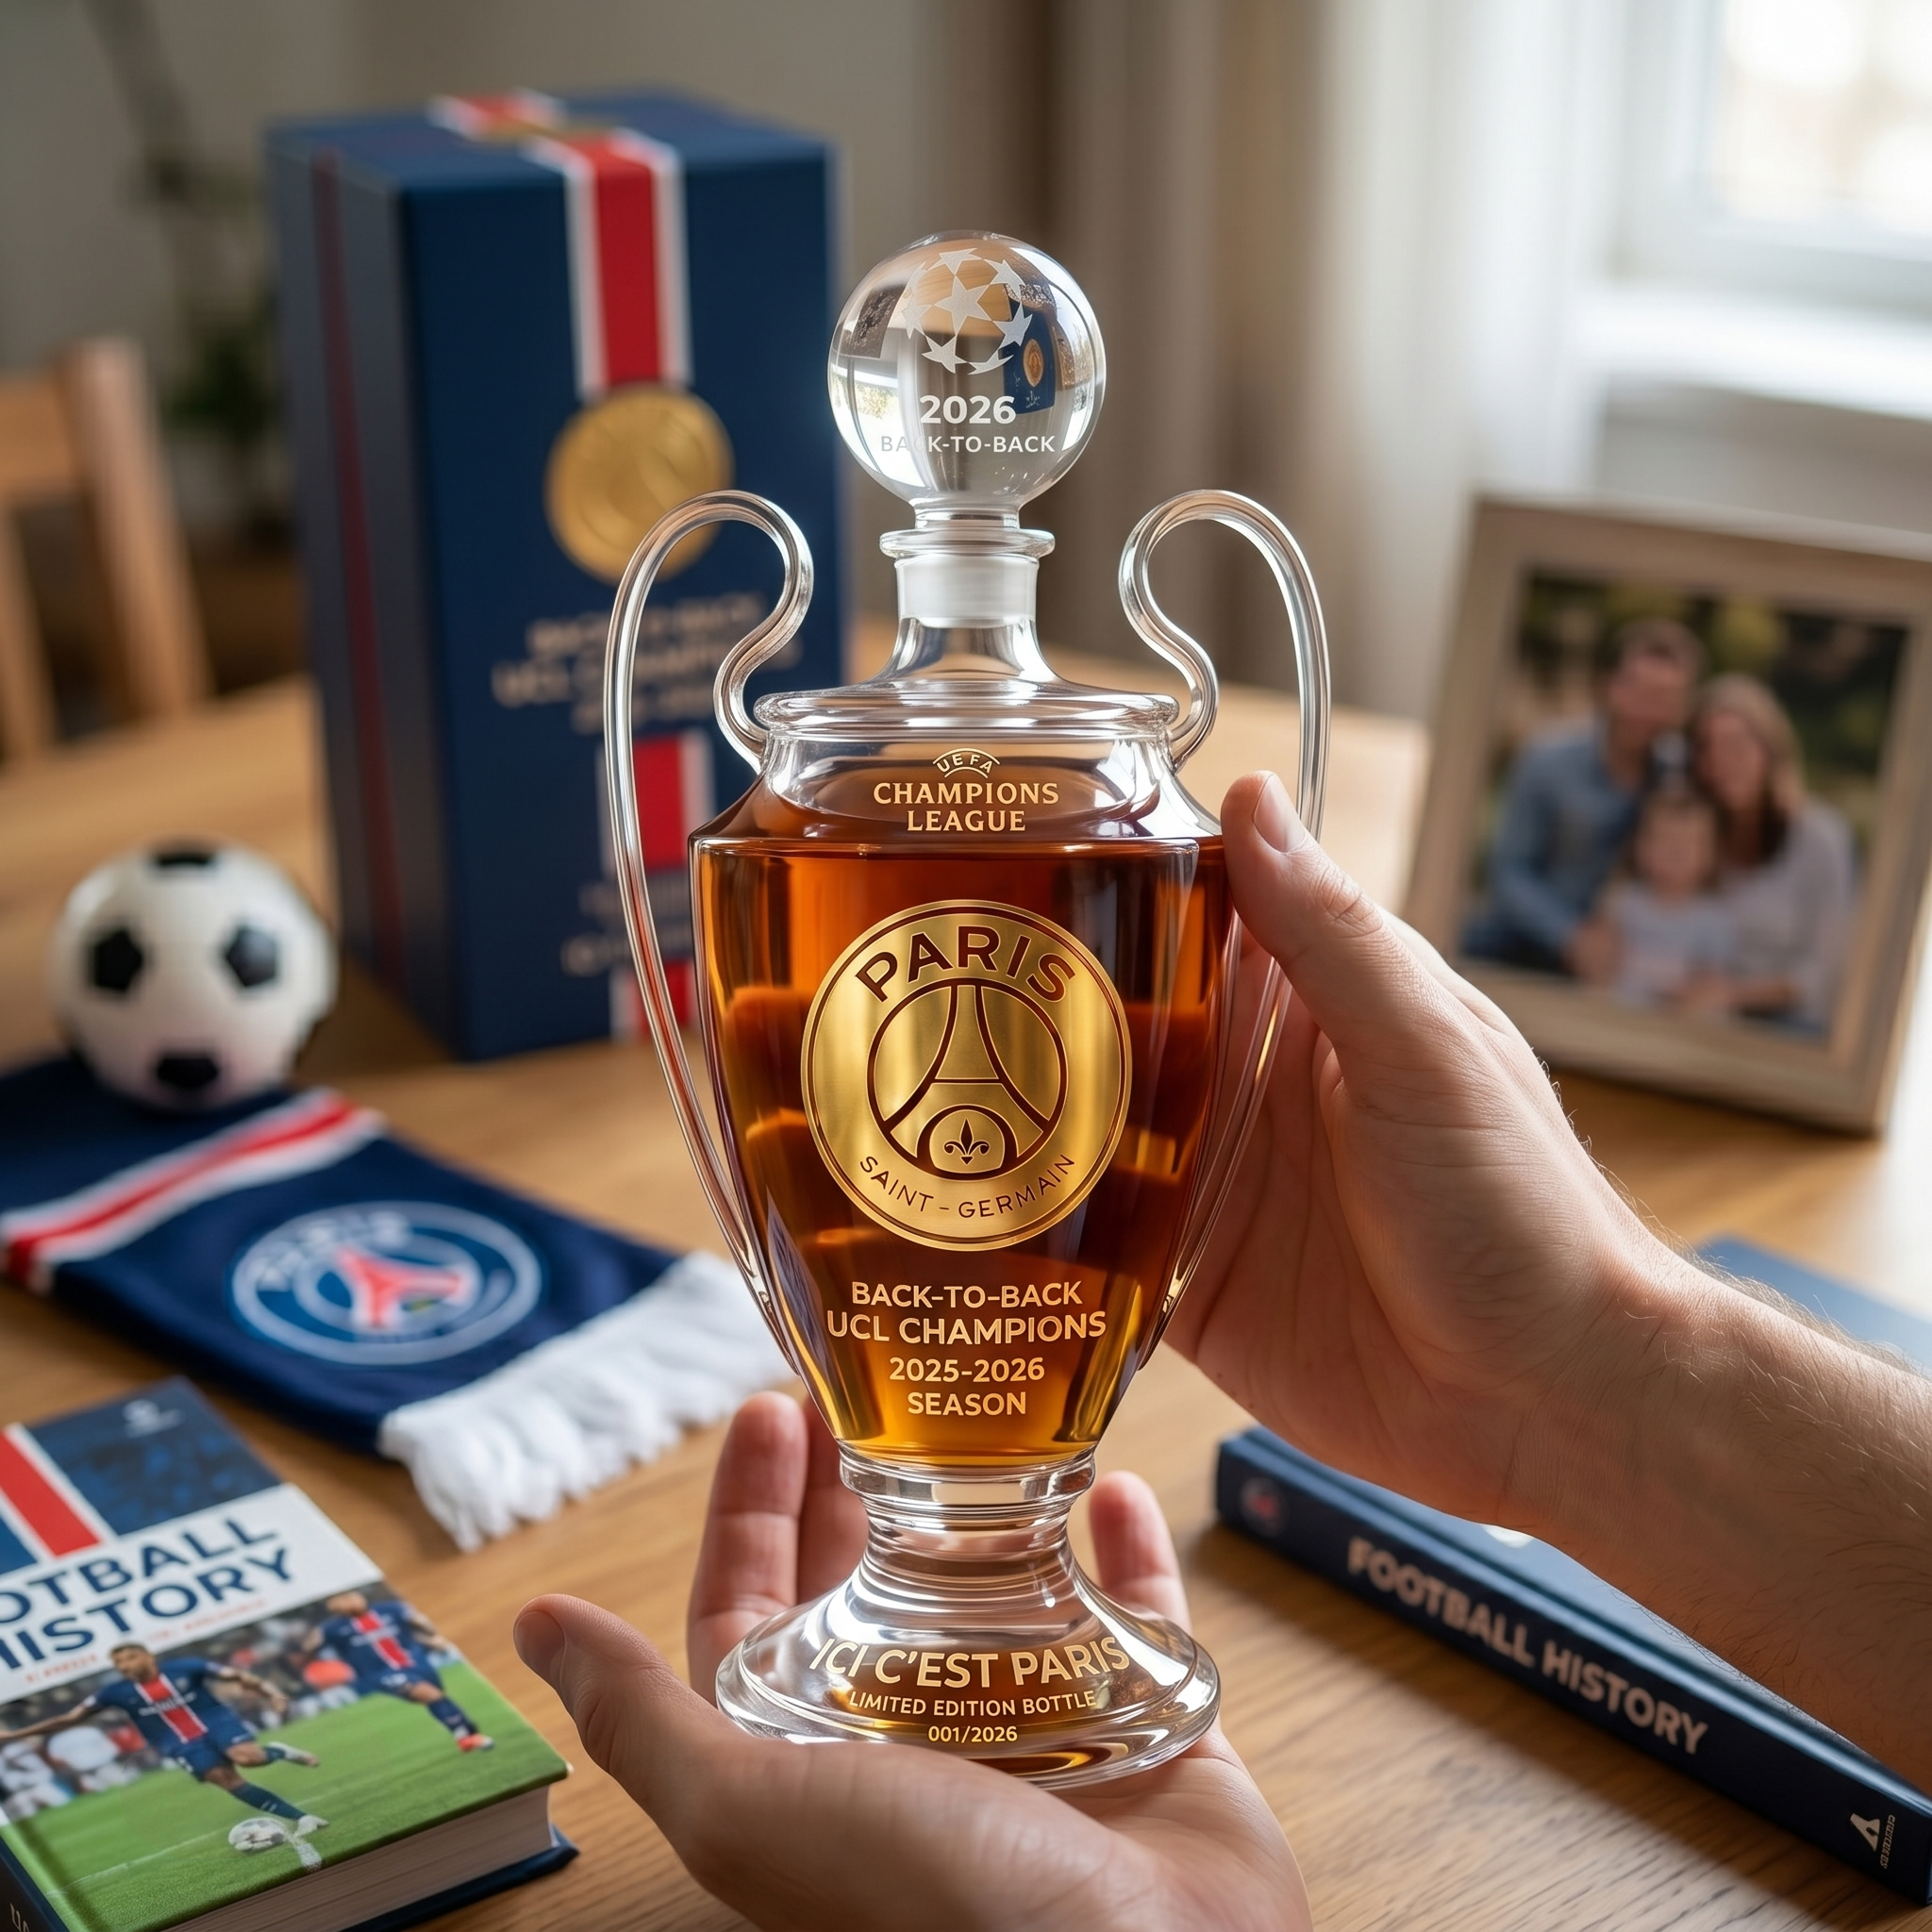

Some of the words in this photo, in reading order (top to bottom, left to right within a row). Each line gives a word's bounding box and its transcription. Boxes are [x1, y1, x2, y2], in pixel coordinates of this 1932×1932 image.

[919, 395, 1016, 424] 2026
[880, 435, 1056, 453] BACK-TO-BACK
[936, 754, 993, 774] UEFA
[873, 782, 1059, 805] CHAMPIONS
[907, 809, 1026, 832] LEAGUE
[855, 925, 1076, 1003] PARIS
[851, 1280, 1084, 1308] BACK-TO-BACK
[826, 1309, 890, 1341] UCL
[898, 1310, 1107, 1345] CHAMPIONS
[889, 1356, 1045, 1383] 2025-2026
[908, 1391, 1026, 1416] SEASON
[1346, 1536, 1536, 1668] FOOTBALL
[1541, 1639, 1708, 1755] HISTORY
[808, 1638, 869, 1678] ICI
[1013, 1636, 1130, 1686] PARIS
[848, 1690, 926, 1715] LIMITED
[933, 1700, 1016, 1717] EDITION
[1023, 1690, 1097, 1715] BOTTLE
[927, 1725, 1018, 1743] 001/2026
